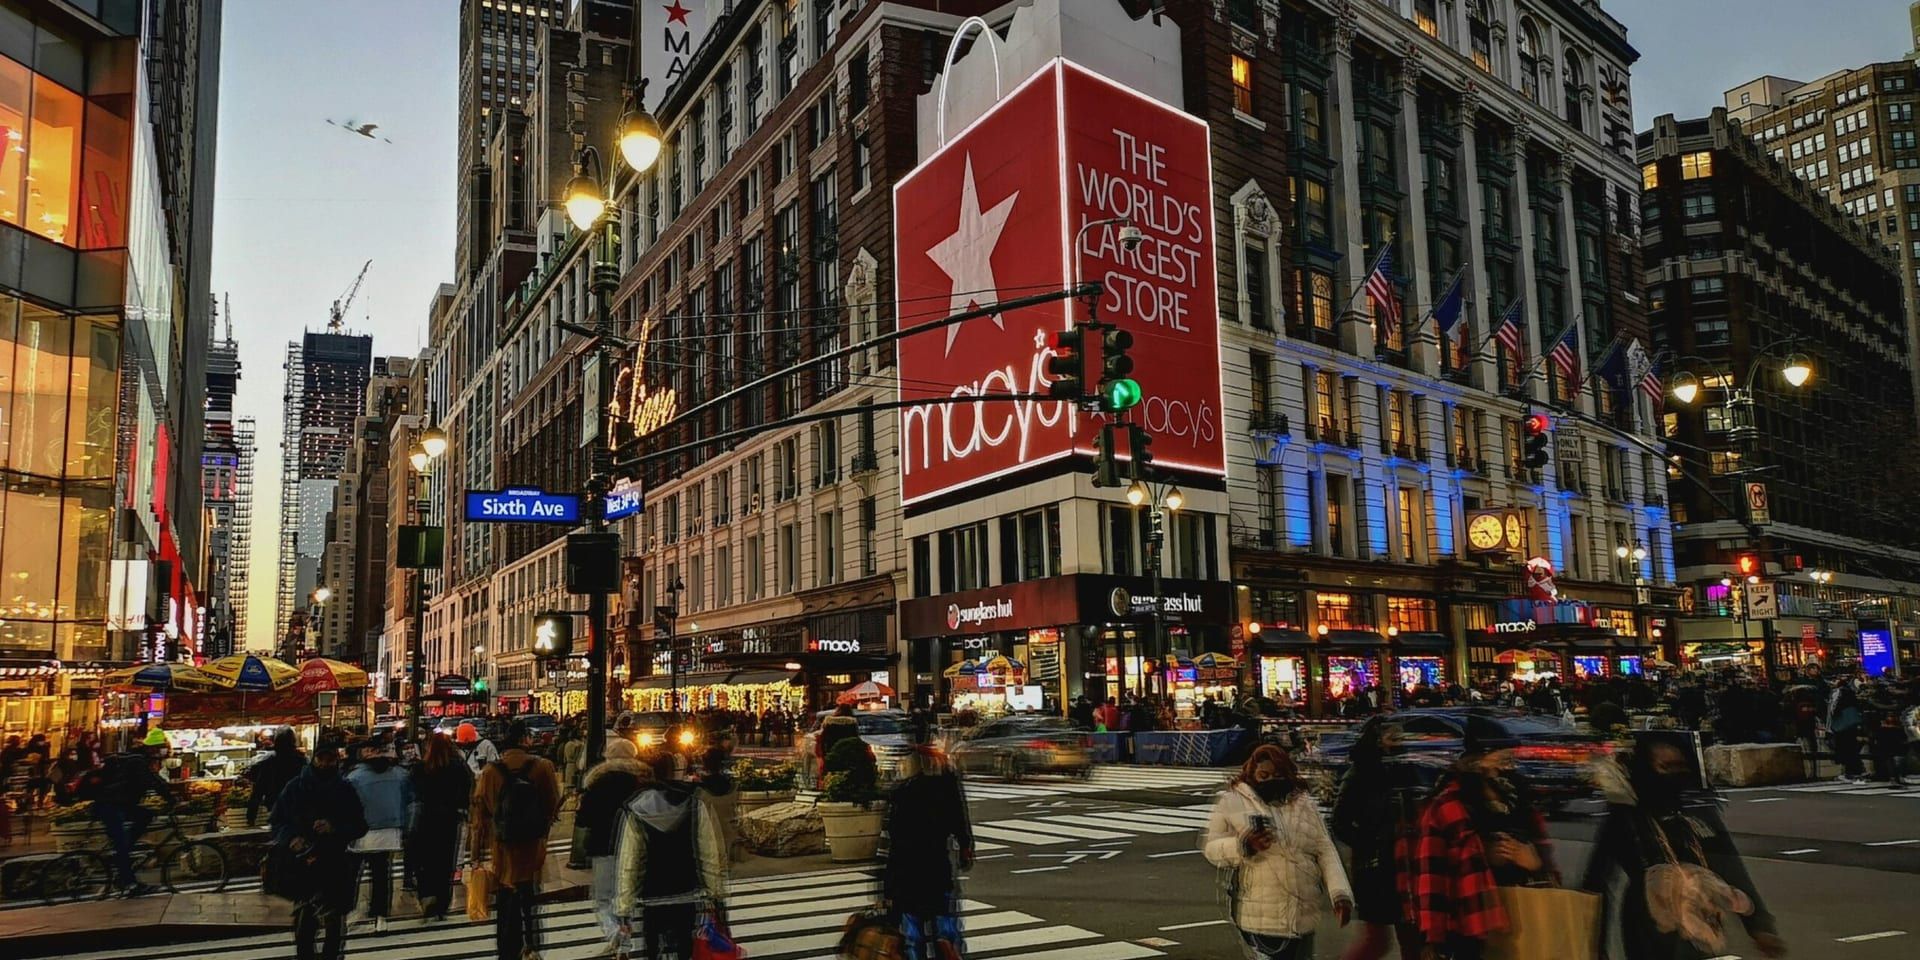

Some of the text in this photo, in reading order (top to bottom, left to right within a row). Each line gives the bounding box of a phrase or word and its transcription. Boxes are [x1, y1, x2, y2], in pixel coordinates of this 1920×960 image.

[665, 27, 690, 91] MA
[1112, 128, 1168, 187] THE
[1077, 162, 1203, 245] WORLD'S
[1082, 213, 1201, 288] LARGEST
[1104, 271, 1190, 333] STORE
[905, 329, 1064, 475] macy's
[1559, 438, 1578, 448] ONLY
[482, 498, 564, 516] Sixth Ave
[1131, 595, 1182, 612] sunass
[1183, 592, 1203, 613] hut
[1750, 585, 1770, 594] KEEP
[960, 598, 1013, 626] sunglass hut
[1494, 618, 1536, 634] macy's
[1751, 607, 1775, 617] RIGHT
[154, 631, 166, 662] FAMOU
[818, 638, 860, 653] macy's
